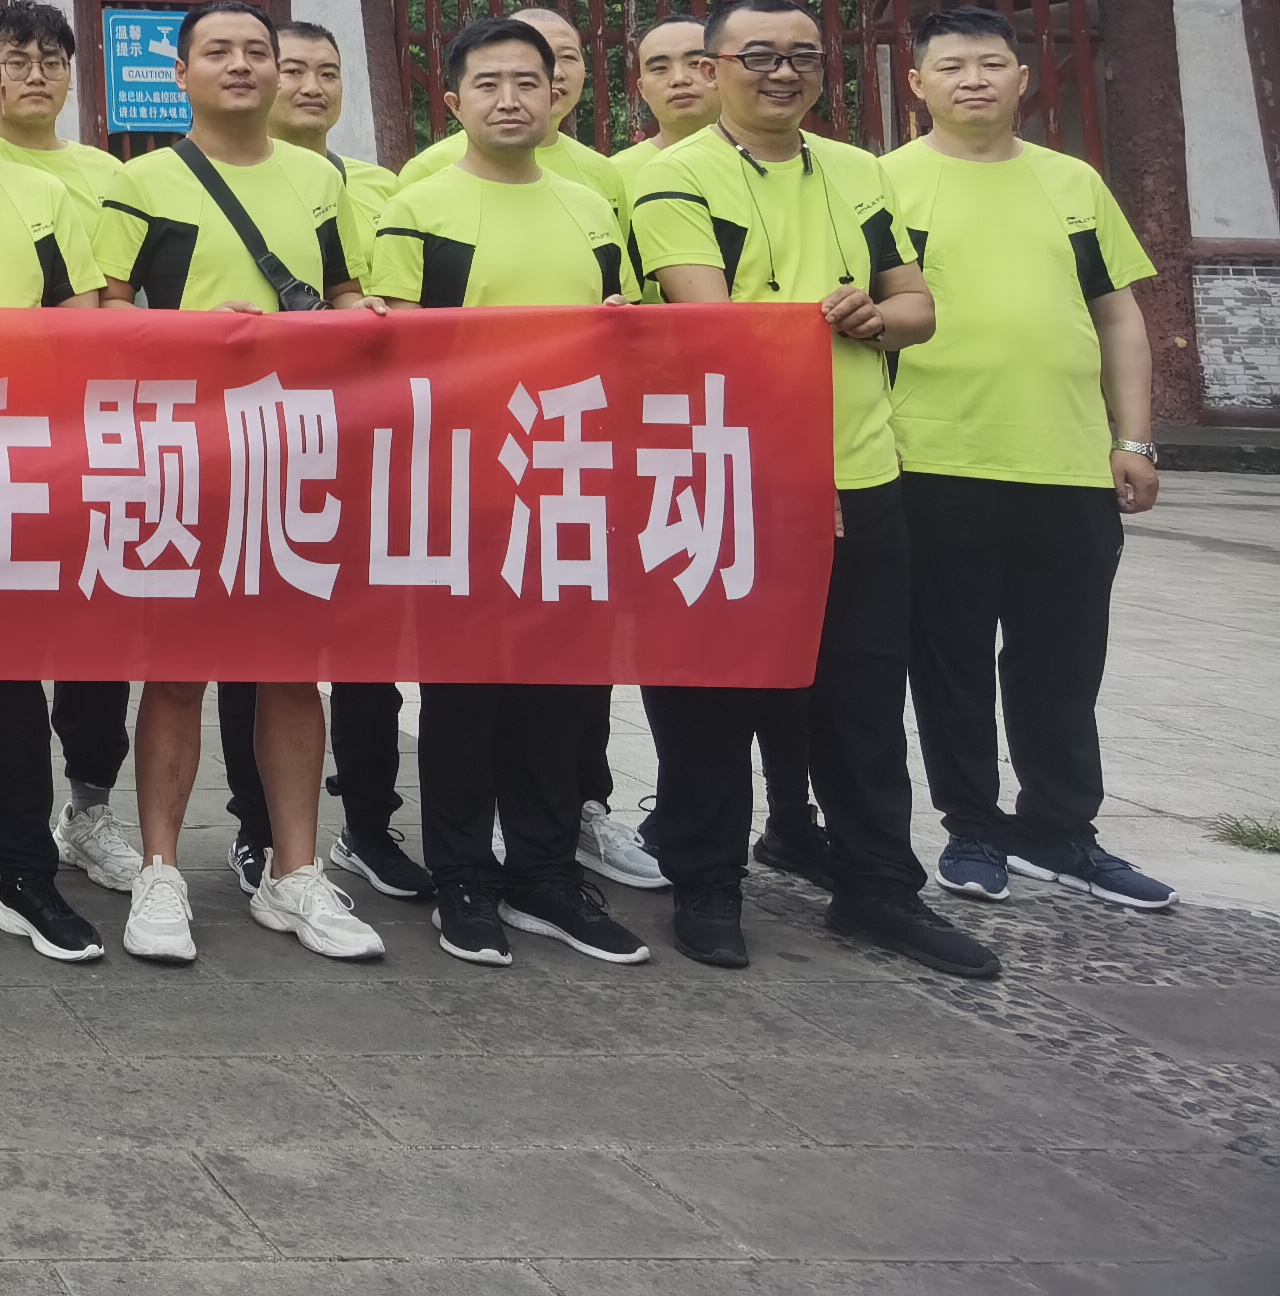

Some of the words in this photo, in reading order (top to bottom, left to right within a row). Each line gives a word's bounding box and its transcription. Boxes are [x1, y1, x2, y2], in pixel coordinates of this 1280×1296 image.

[115, 25, 142, 40] 温馨
[116, 42, 143, 57] 提示
[127, 69, 172, 80] CAUTION
